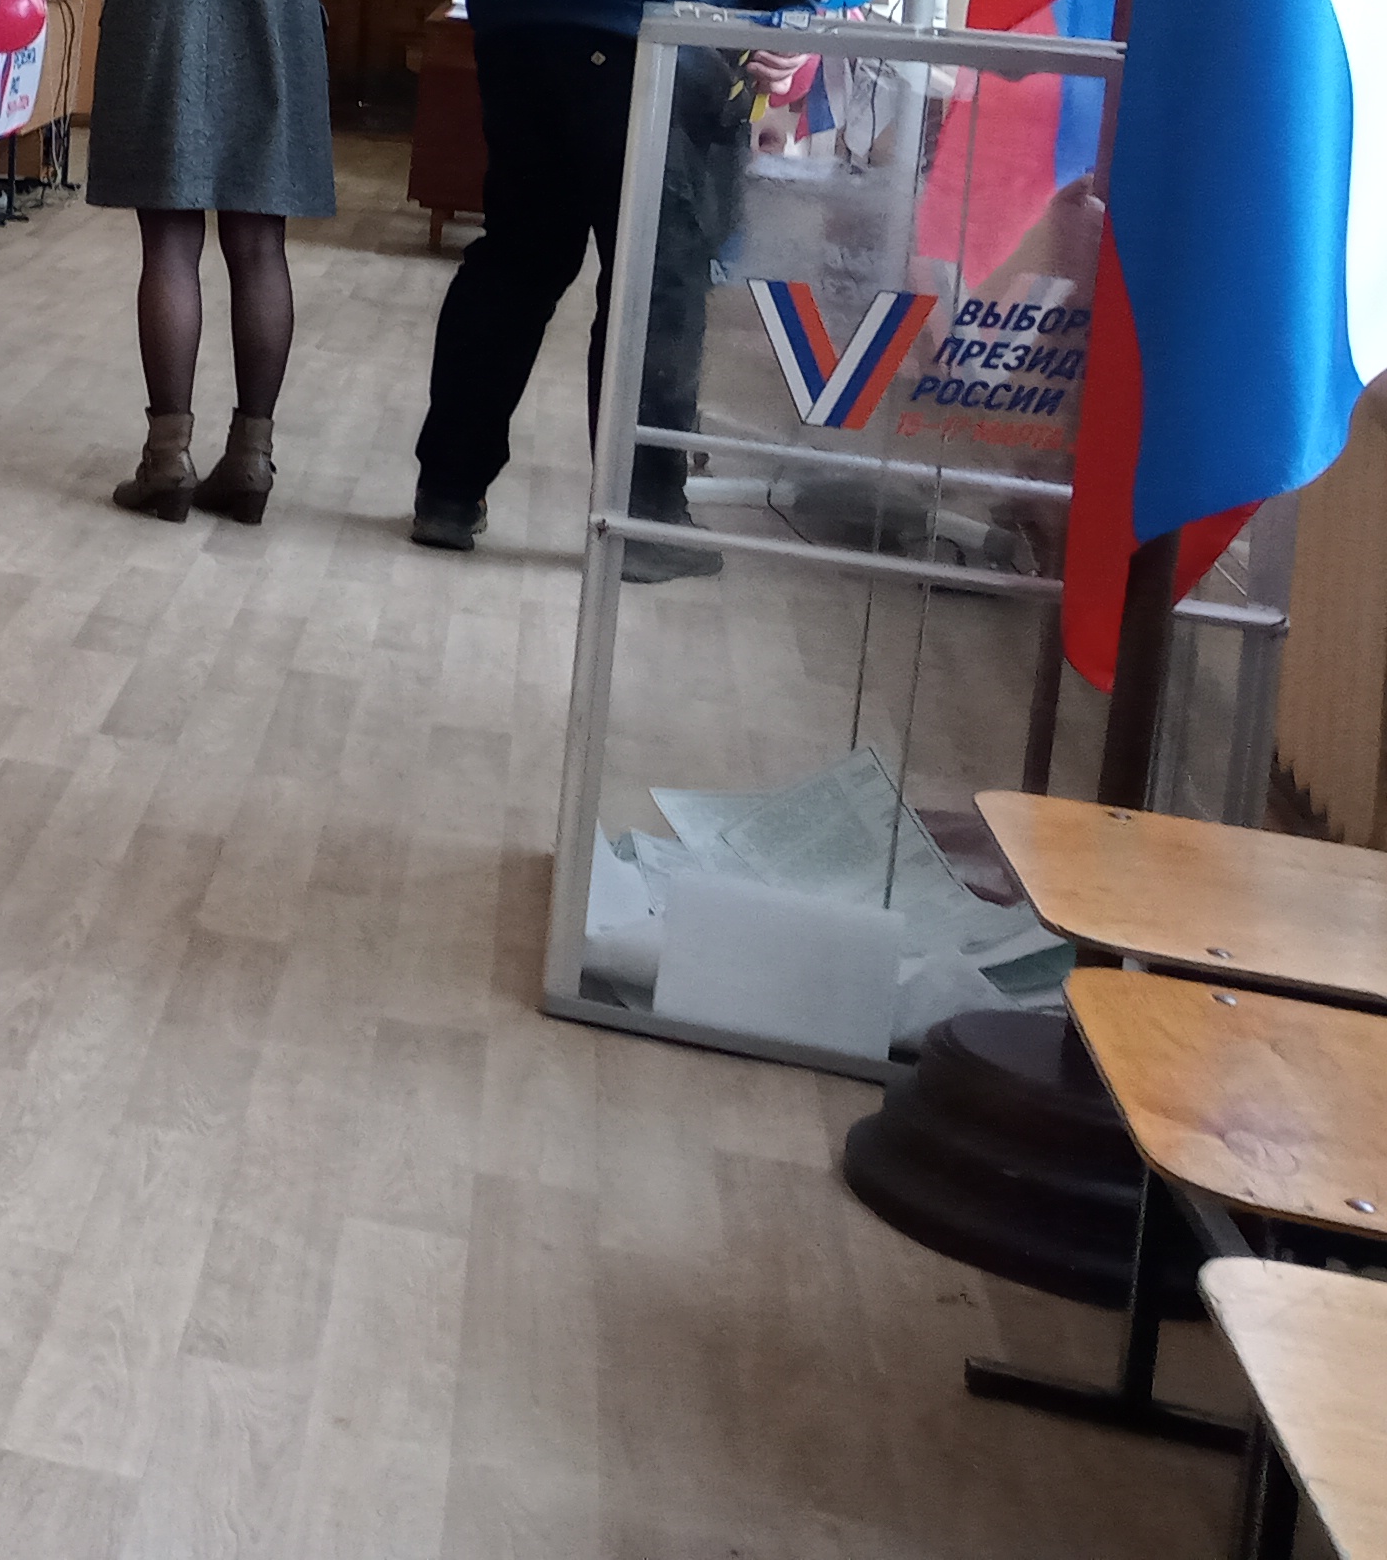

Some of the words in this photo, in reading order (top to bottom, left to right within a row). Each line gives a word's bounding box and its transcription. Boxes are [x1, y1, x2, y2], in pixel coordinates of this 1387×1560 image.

[954, 298, 1093, 335] ВЫБОР
[933, 333, 1087, 380] ПРЕЗИД
[910, 375, 1065, 417] РОССИИ
